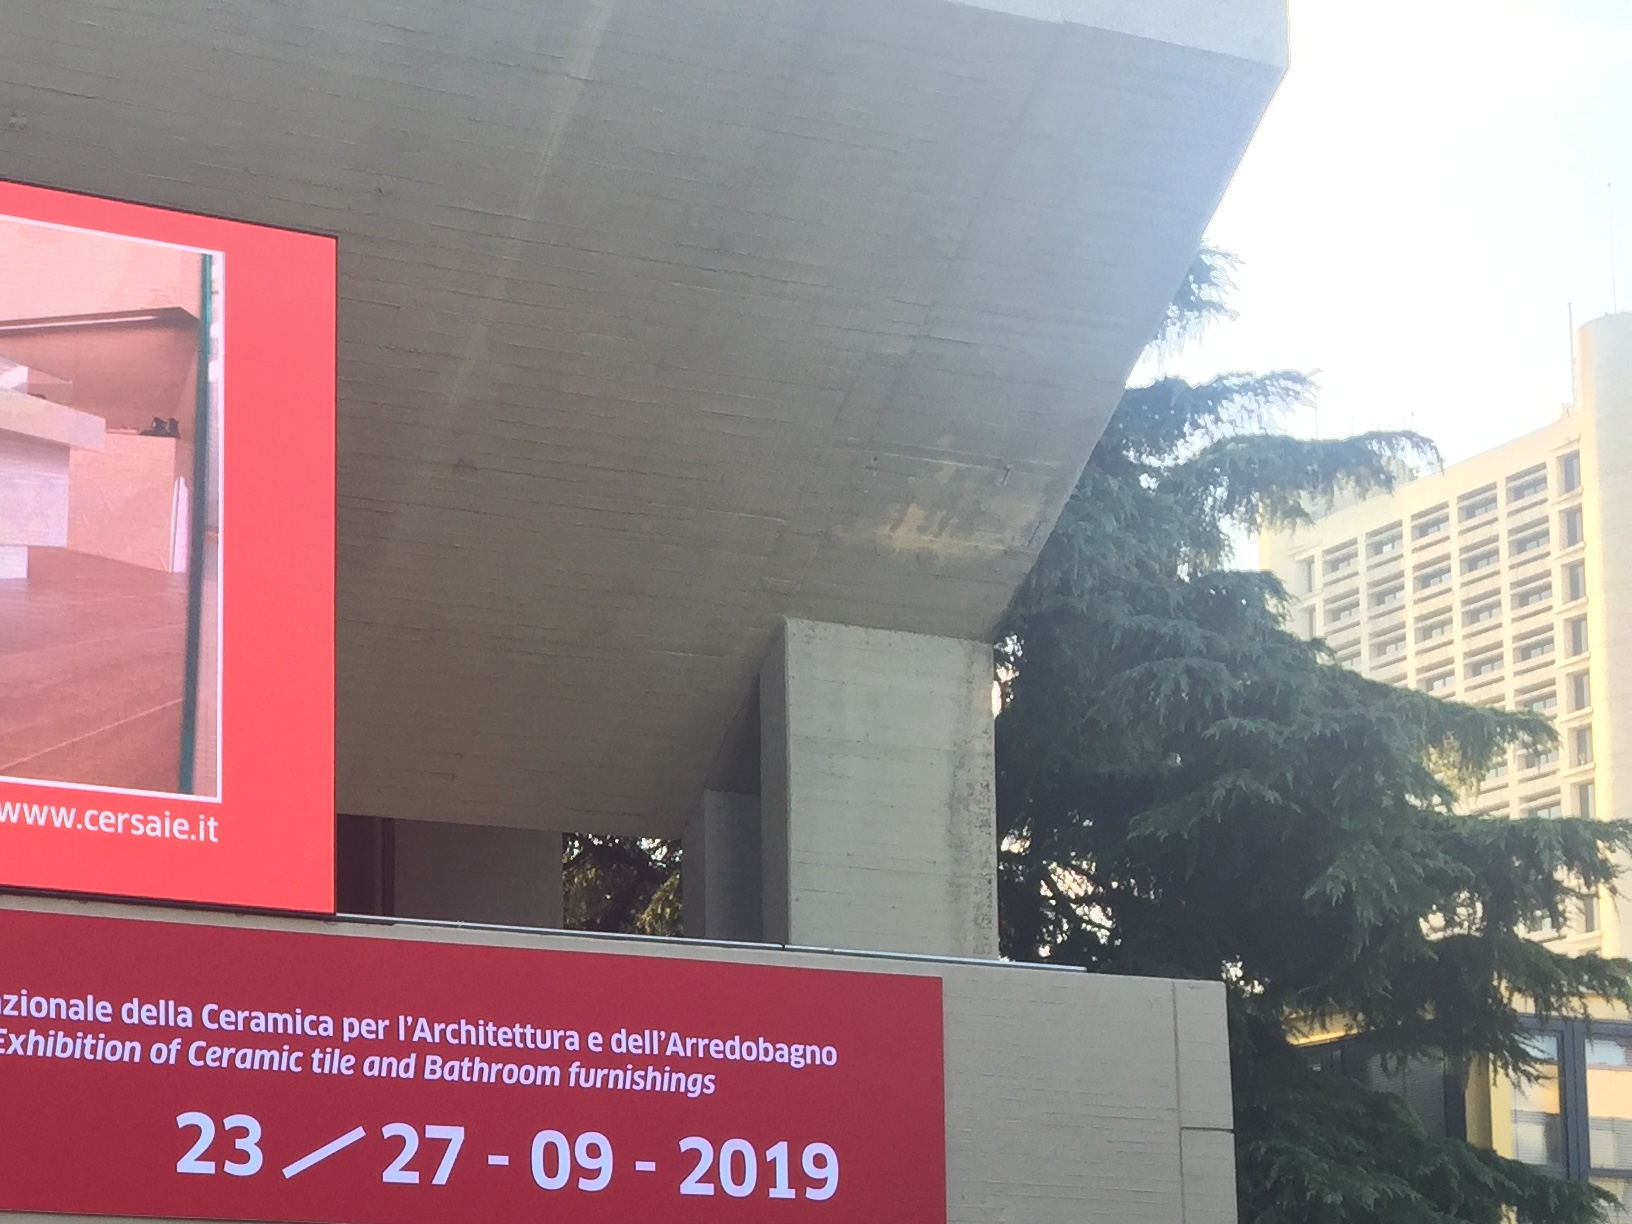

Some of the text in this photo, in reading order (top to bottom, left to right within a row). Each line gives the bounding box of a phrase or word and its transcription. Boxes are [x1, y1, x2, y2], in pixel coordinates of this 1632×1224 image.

[121, 996, 193, 1028] della
[201, 1003, 334, 1039] Ceramica
[343, 1016, 390, 1045] per
[397, 1014, 580, 1052] l'Architettura
[587, 1033, 603, 1052] e
[610, 1026, 838, 1068] dell'Arredobagno
[149, 1037, 181, 1066] of
[188, 1040, 304, 1073] Ceramic
[311, 1047, 355, 1075] tile
[363, 1052, 414, 1079] and
[424, 1054, 561, 1087] Bathroom
[567, 1061, 716, 1098] furnishings
[175, 1111, 264, 1176] 23
[381, 1122, 466, 1185] 27
[530, 1130, 614, 1192] 09
[678, 1136, 839, 1201] 2019
